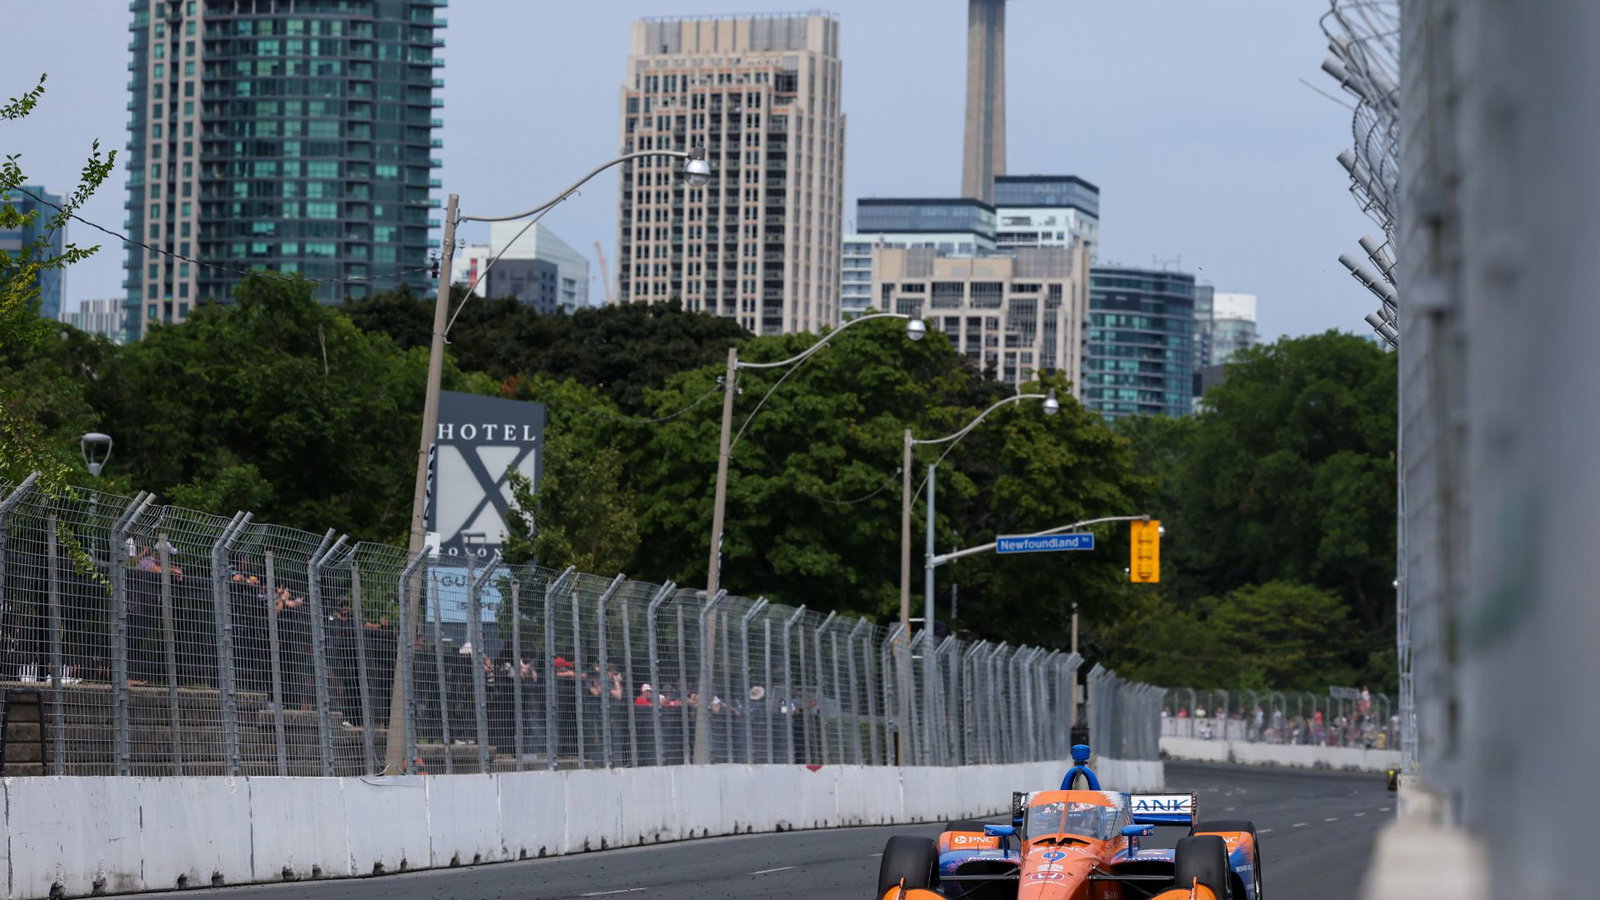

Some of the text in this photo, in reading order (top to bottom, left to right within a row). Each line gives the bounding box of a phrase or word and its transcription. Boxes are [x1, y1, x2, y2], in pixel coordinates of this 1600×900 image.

[437, 423, 537, 442] HOTEL
[1001, 537, 1079, 550] Newfoundland
[1134, 799, 1189, 812] ANK
[968, 835, 995, 843] PNC
[1222, 836, 1239, 844] NC
